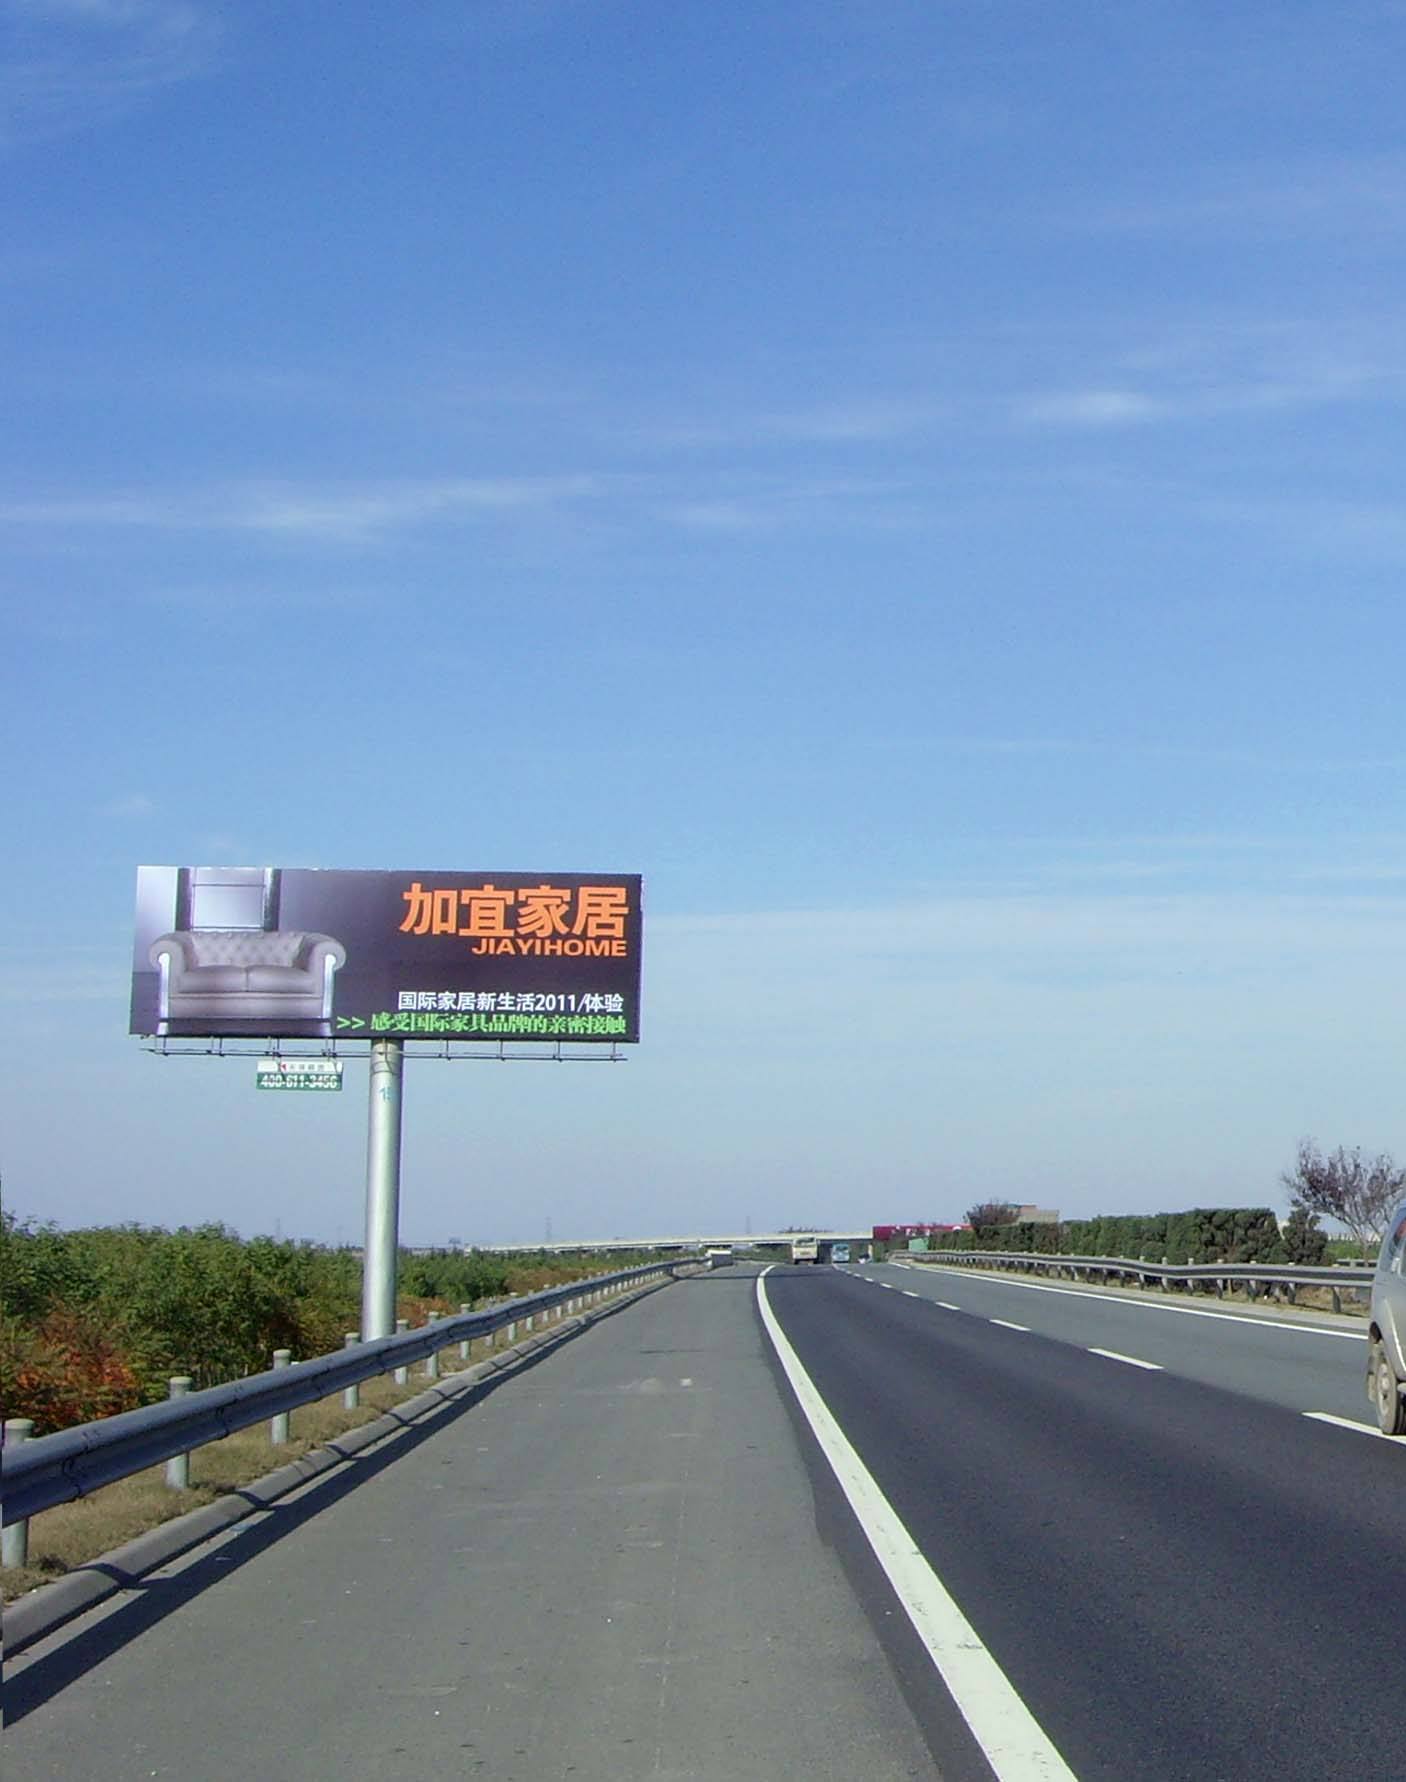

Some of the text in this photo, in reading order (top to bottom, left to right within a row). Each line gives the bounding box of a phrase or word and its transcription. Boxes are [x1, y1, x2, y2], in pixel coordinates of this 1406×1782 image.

[400, 883, 629, 938] 加宜家居
[471, 938, 627, 957] JIAYIHOME
[398, 991, 624, 1013] 国际家居新生活2011/体验
